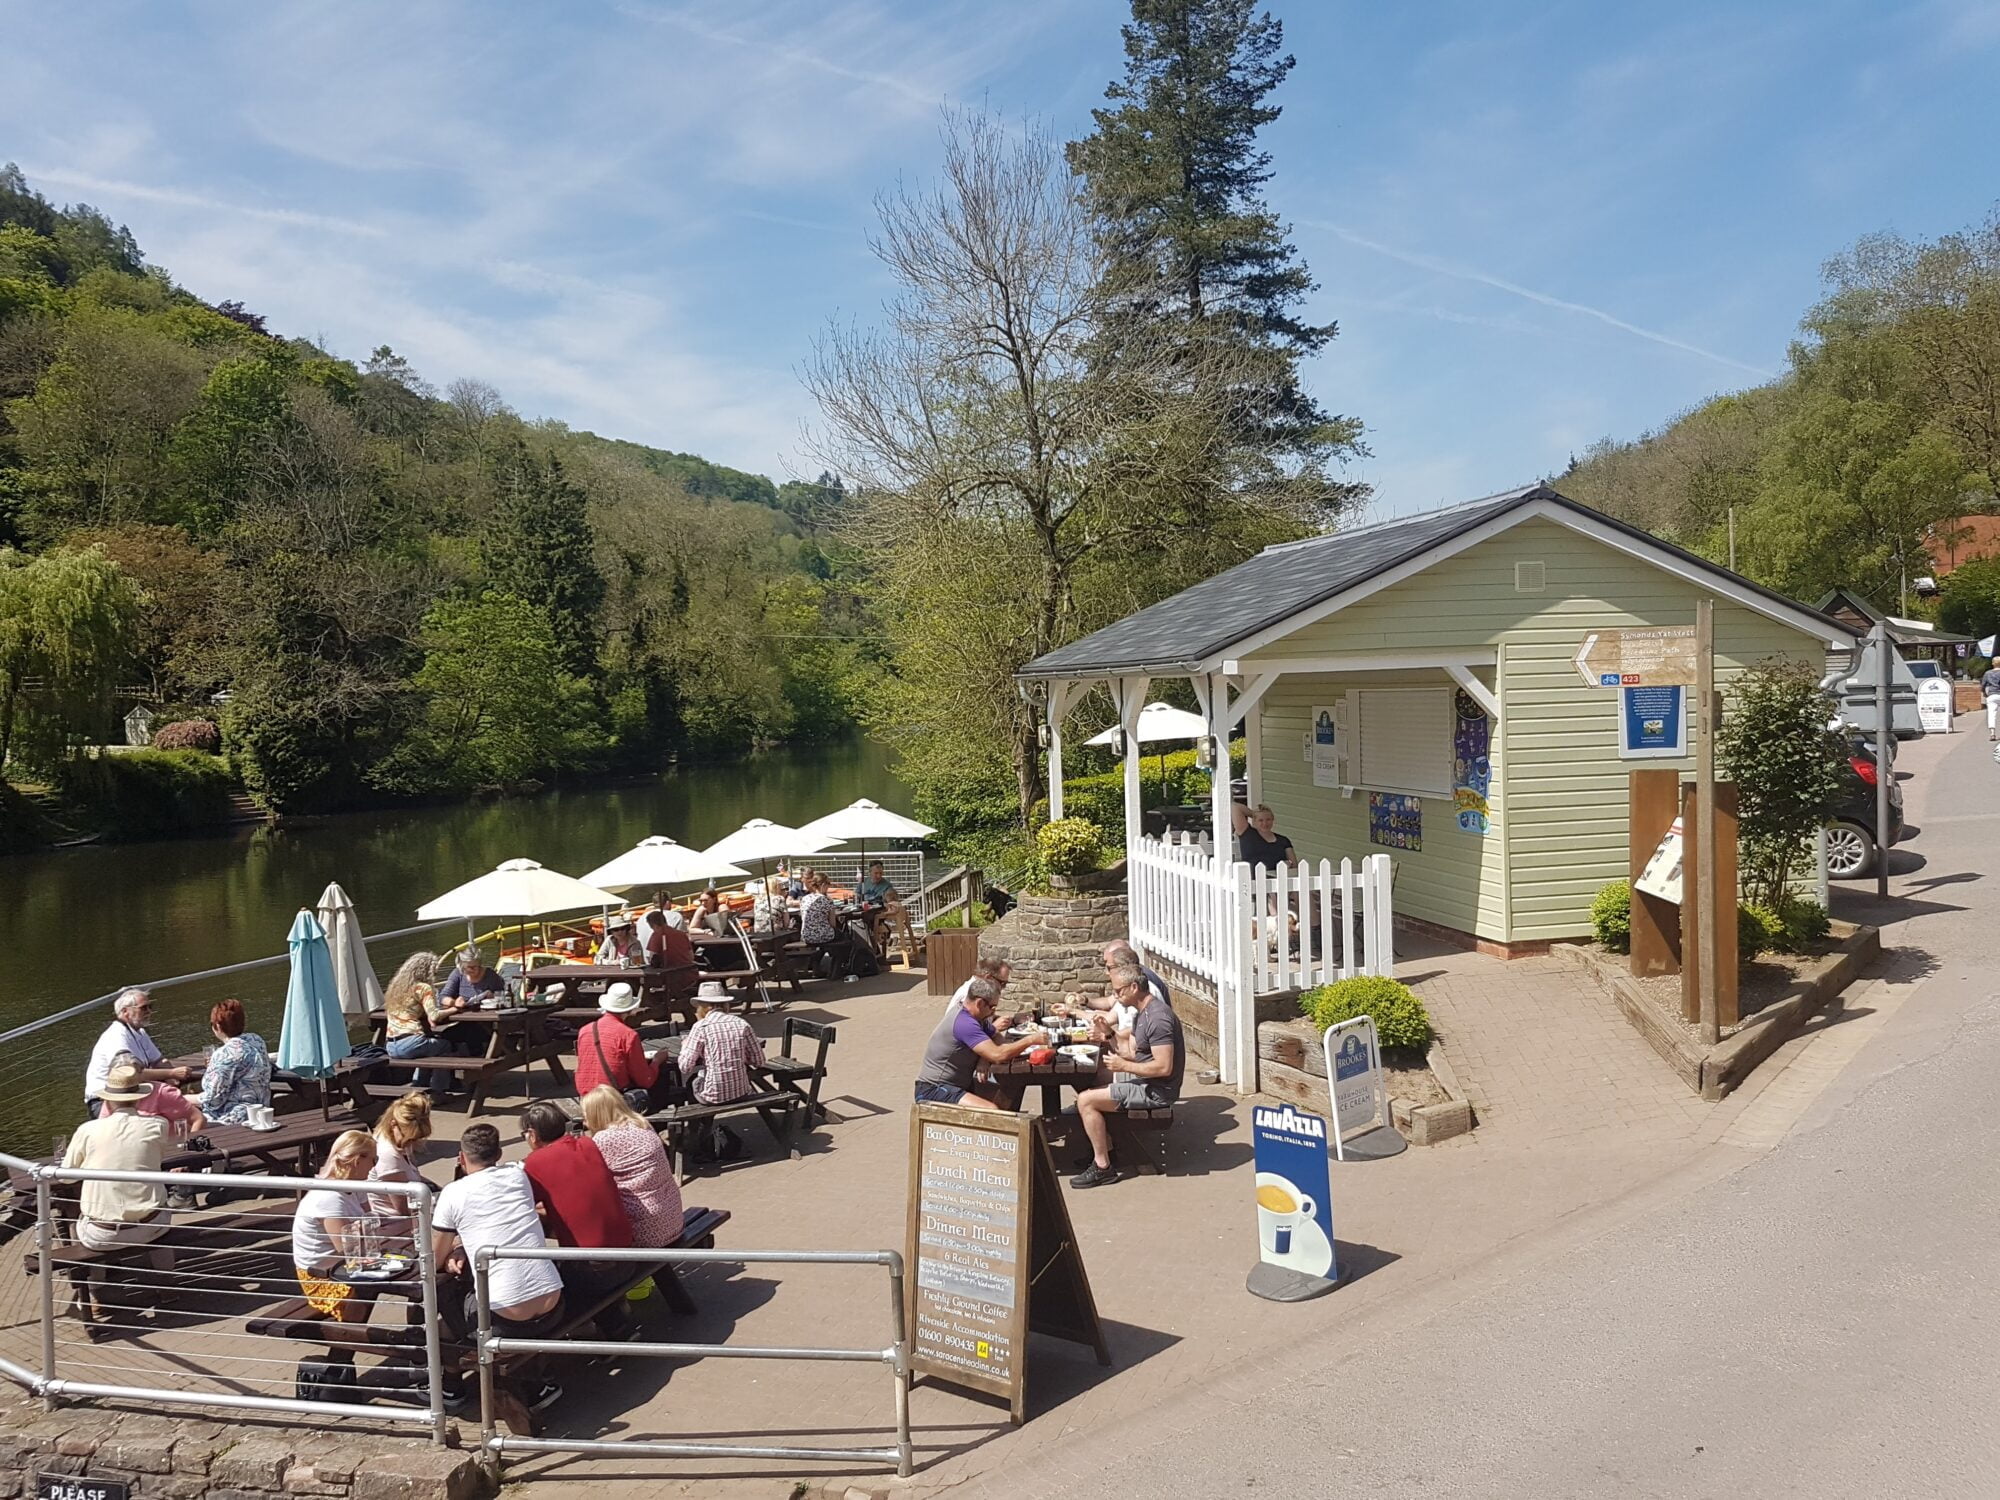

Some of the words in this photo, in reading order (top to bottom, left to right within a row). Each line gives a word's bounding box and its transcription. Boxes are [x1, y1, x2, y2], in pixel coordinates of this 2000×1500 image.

[1620, 631, 1656, 640] Symonds
[1622, 675, 1639, 684] 423
[1349, 1093, 1371, 1109] CREAM
[1255, 1107, 1324, 1138] LAVAZZA
[926, 1126, 942, 1140] Bar
[944, 1129, 973, 1146] Open
[975, 1134, 990, 1148] All
[991, 1136, 1017, 1155] Day
[973, 1151, 990, 1164] Day
[928, 1160, 967, 1180] Lunch
[972, 1167, 1011, 1187] Menu
[926, 1216, 966, 1237] Dinner
[972, 1225, 1010, 1246] Menu
[944, 1251, 950, 1261] 6
[952, 1253, 970, 1265] Real
[973, 1257, 989, 1270] Ales
[923, 1289, 950, 1307] Freshly
[952, 1296, 981, 1312] Ground
[982, 1303, 1009, 1319] Coffee
[918, 1327, 942, 1343] 01600
[919, 1313, 950, 1329] Riverside
[952, 1322, 1010, 1346] Accommodation
[51, 1485, 107, 1500] PLEASE
